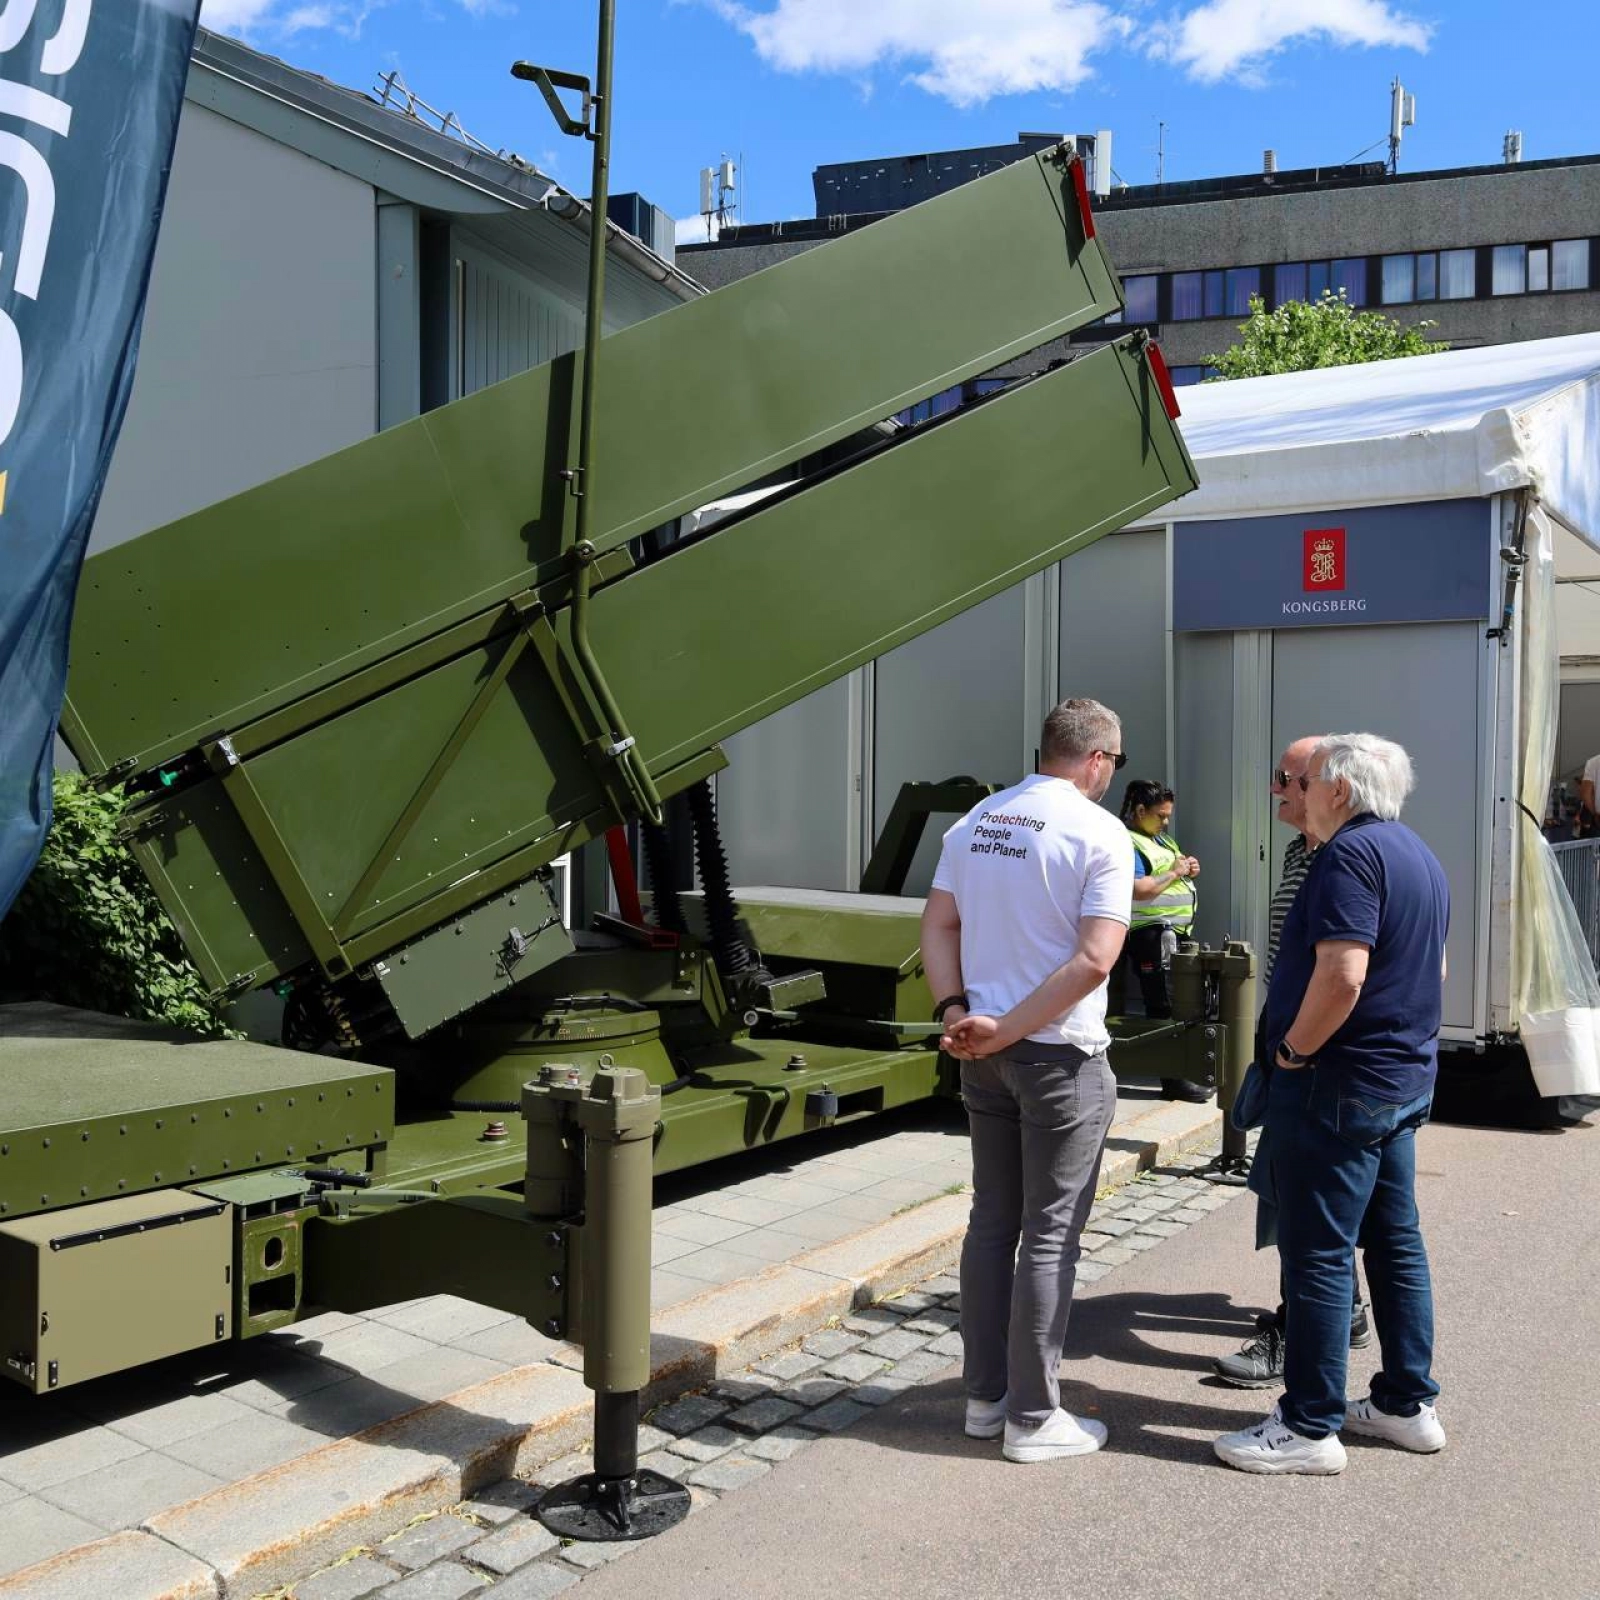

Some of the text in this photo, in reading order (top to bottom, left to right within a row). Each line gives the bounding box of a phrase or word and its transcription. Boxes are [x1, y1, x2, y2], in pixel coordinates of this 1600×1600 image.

[1282, 599, 1366, 614] KONGSBERG
[980, 812, 1046, 831] Protechting
[974, 826, 1012, 841] People
[970, 842, 1027, 859] and Planet
